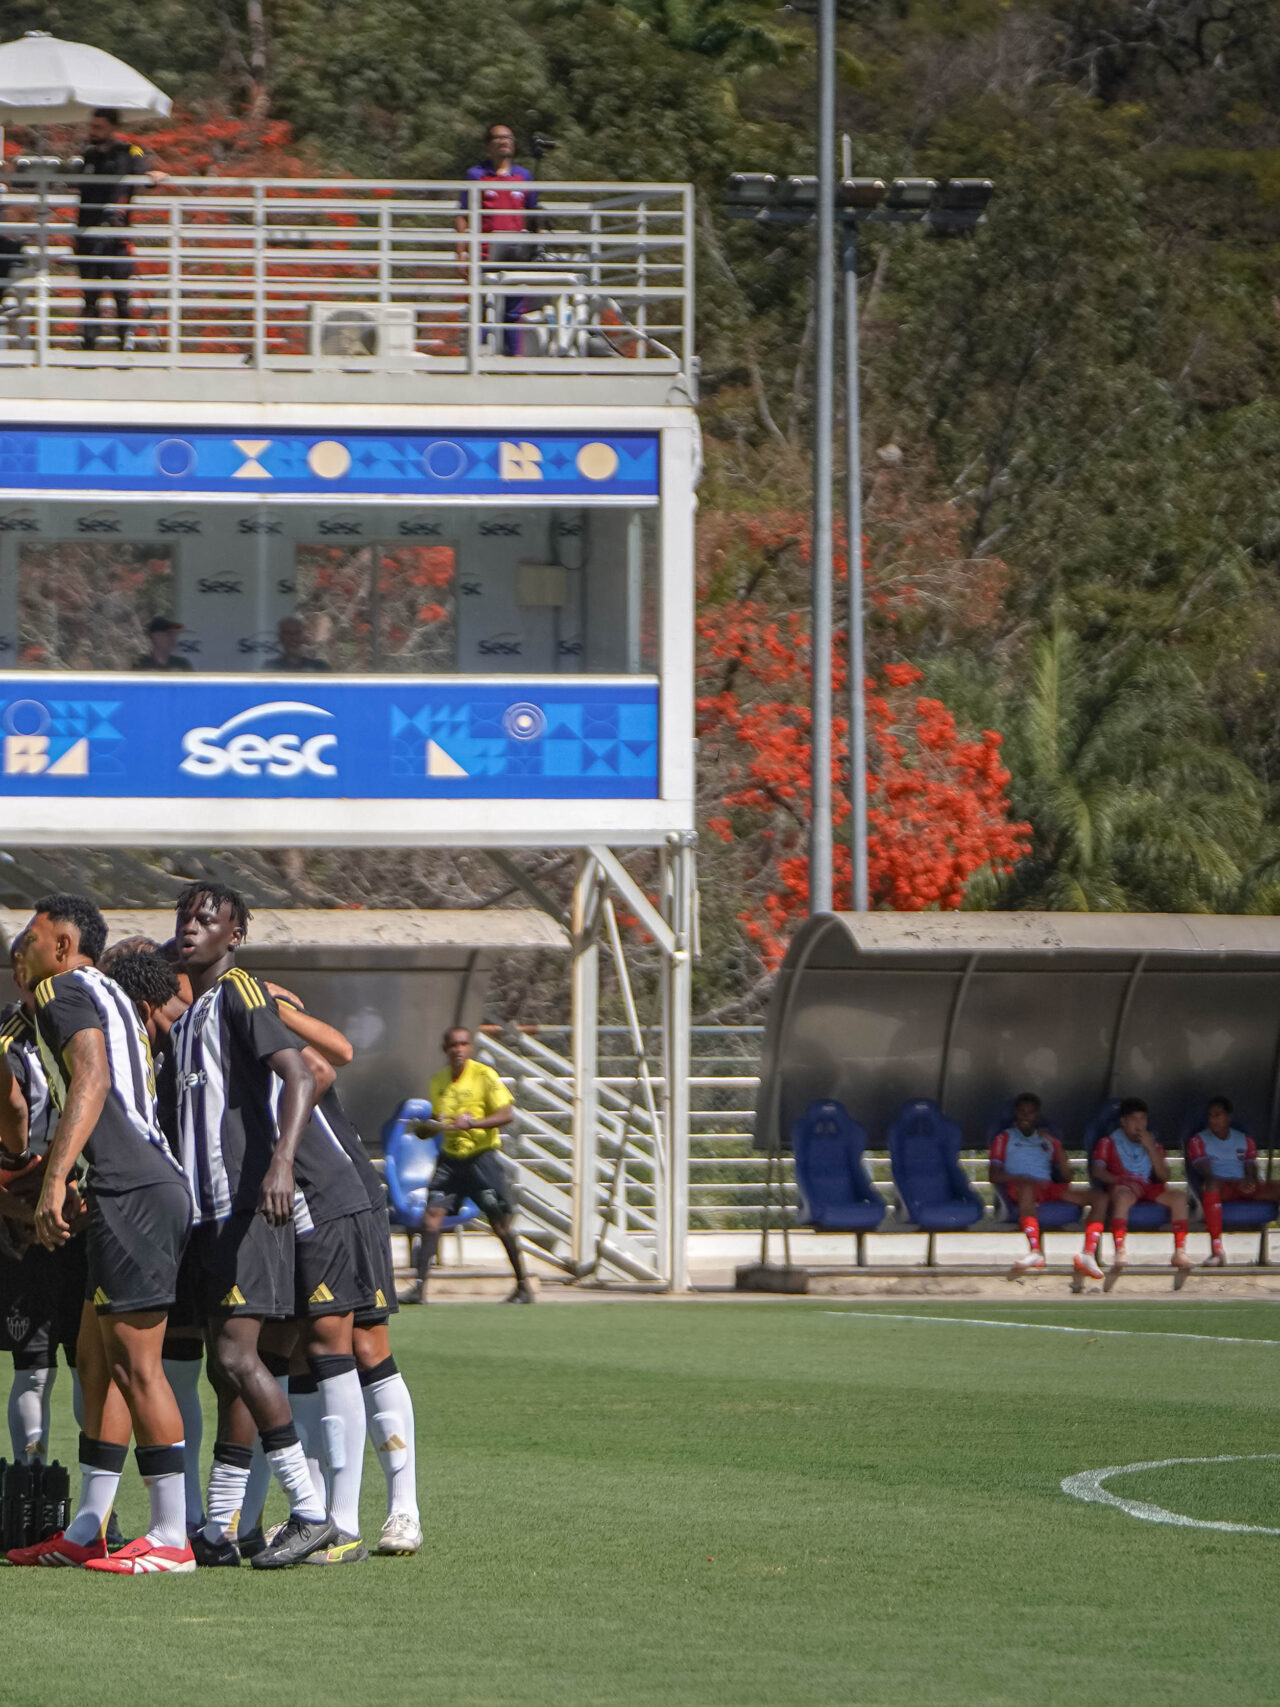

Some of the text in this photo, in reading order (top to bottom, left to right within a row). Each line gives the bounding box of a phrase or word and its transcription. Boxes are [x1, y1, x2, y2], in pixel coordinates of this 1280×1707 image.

[77, 516, 123, 533] Sesc
[156, 517, 202, 534] Sesc
[237, 517, 283, 534] Sesc
[317, 518, 363, 535] Sesc
[397, 519, 443, 536] Sesc
[477, 520, 523, 537] Sesc
[557, 521, 583, 536] Se
[196, 577, 243, 595] Sesc
[460, 582, 483, 596] sc
[176, 638, 202, 653] sc
[476, 639, 523, 656] Sesc
[557, 639, 583, 656] Se
[179, 701, 338, 777] Sesc
